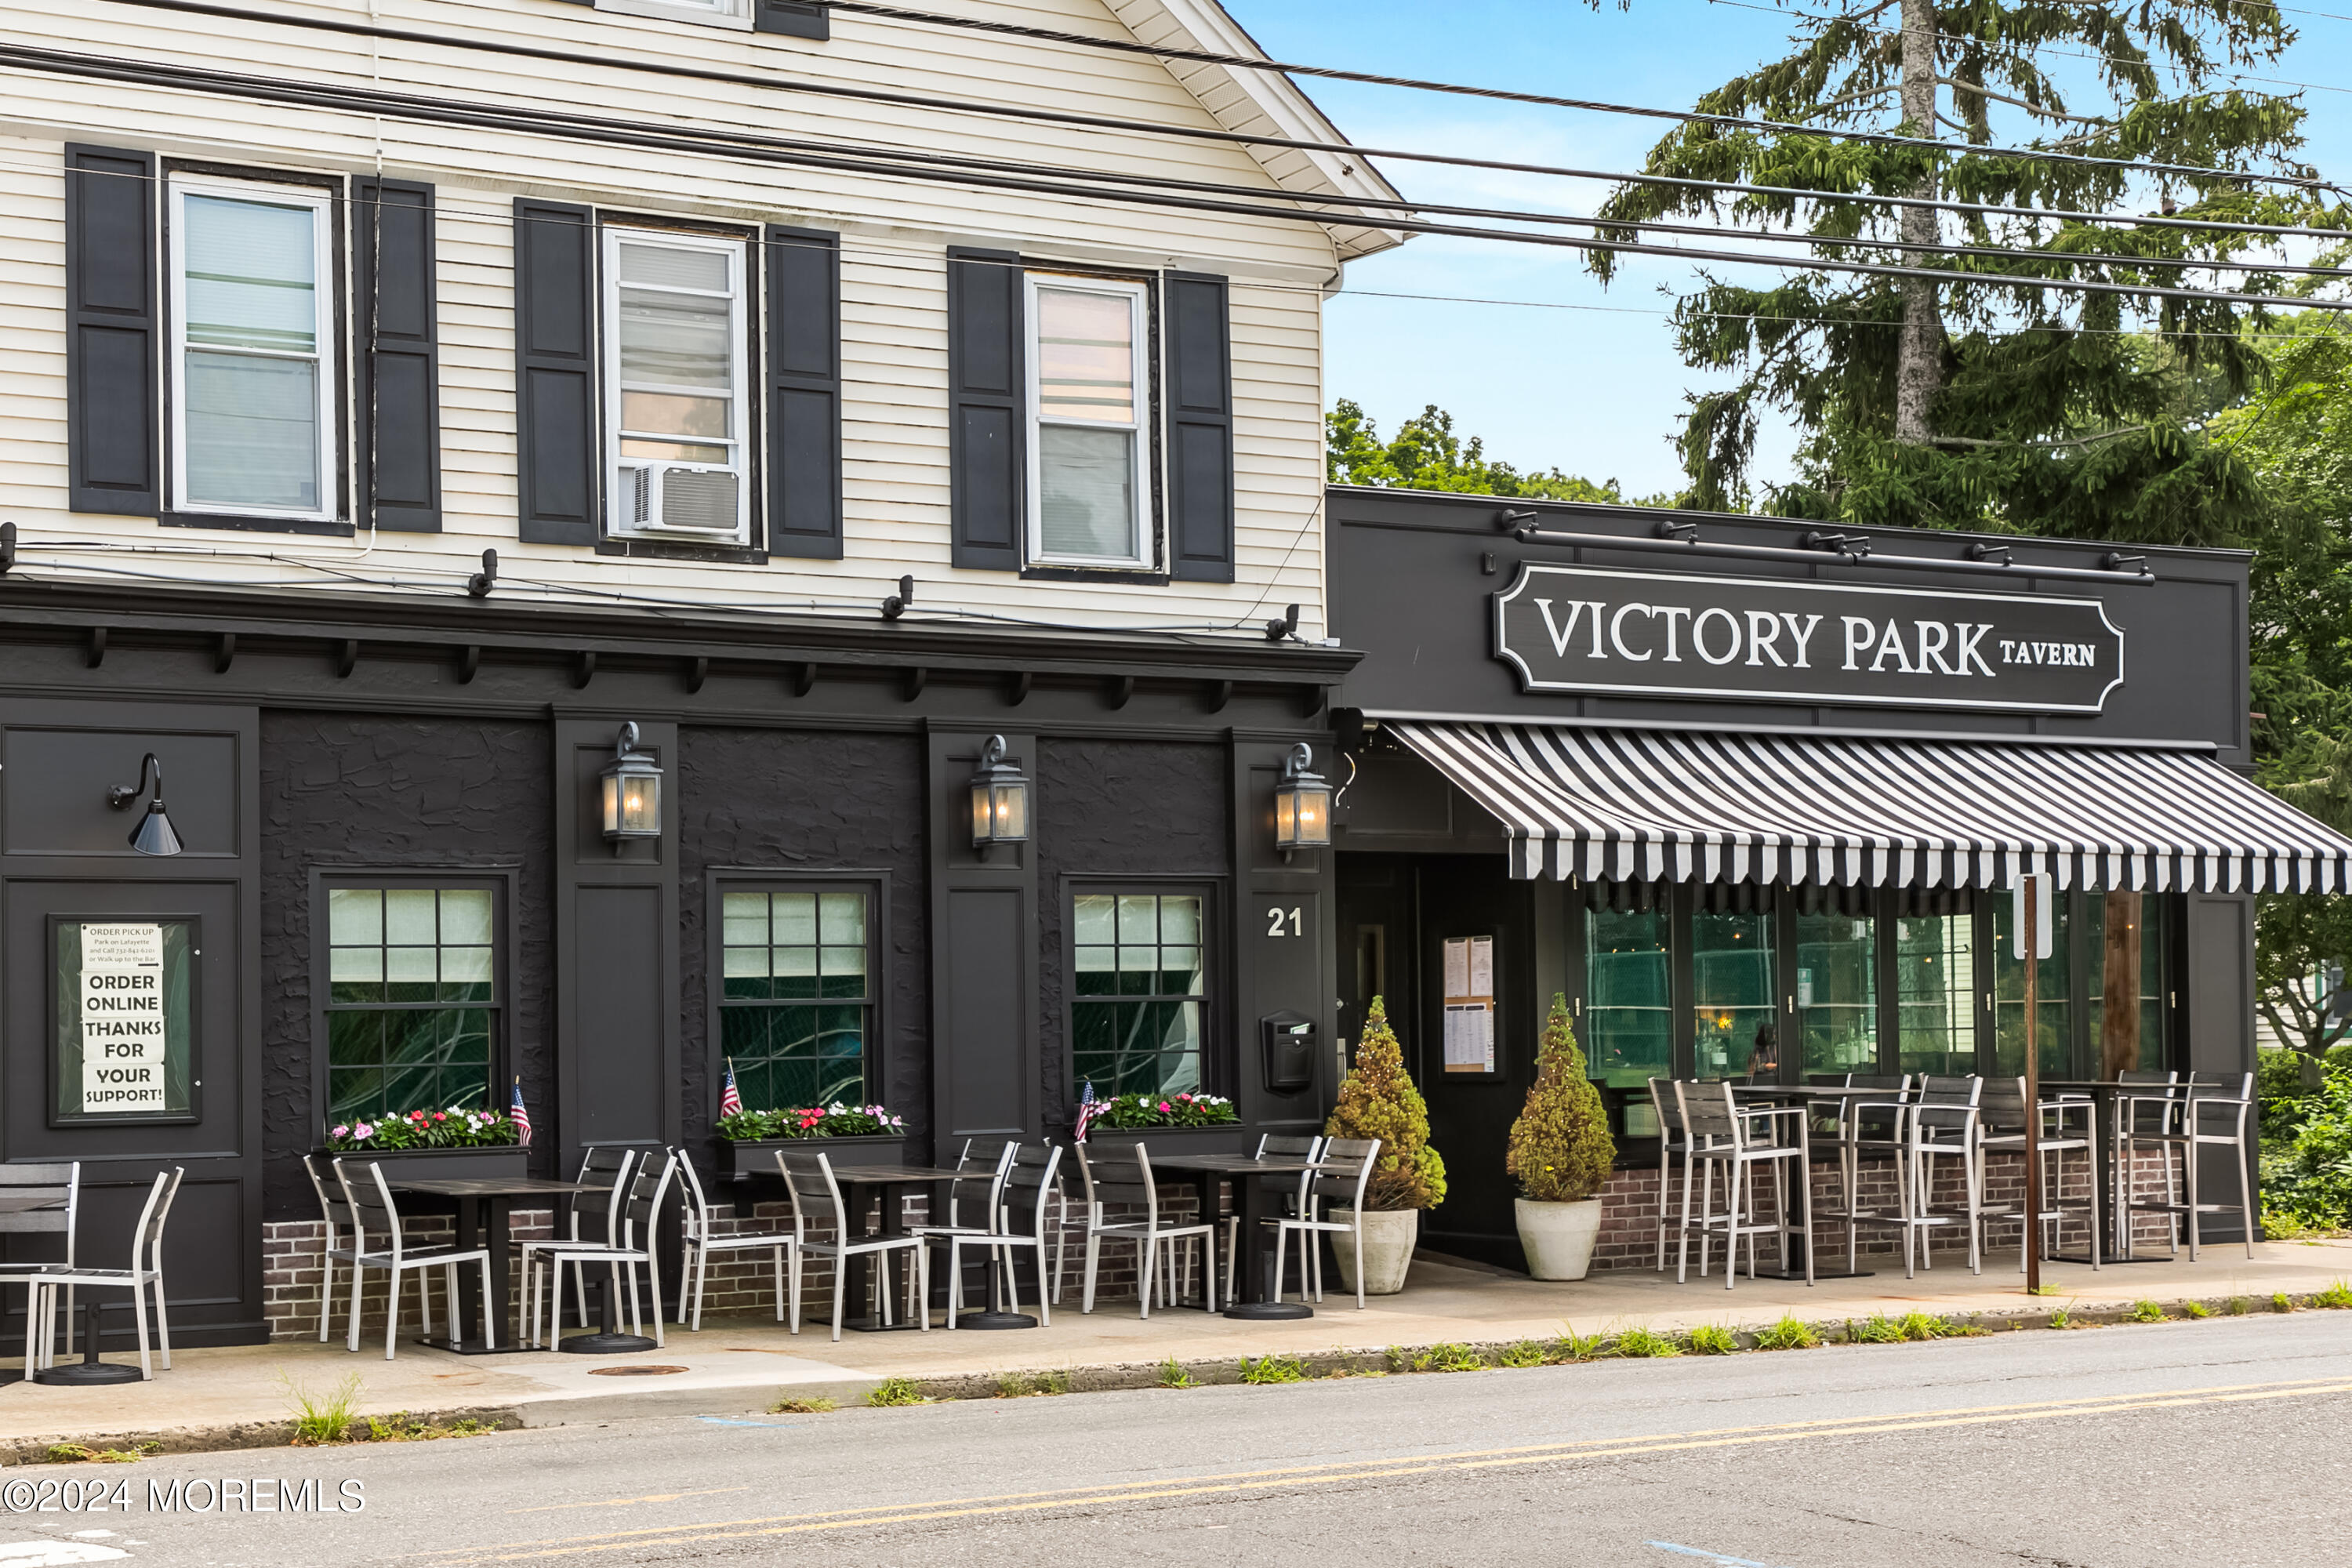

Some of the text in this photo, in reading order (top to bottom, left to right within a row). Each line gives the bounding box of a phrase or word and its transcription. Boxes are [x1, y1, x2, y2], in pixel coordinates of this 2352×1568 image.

[1534, 598, 2096, 677] VICTORY PARK TAVERN
[1268, 907, 1301, 936] 21
[89, 975, 154, 989] ORDER
[86, 996, 158, 1011] ONLINE
[85, 1021, 162, 1036] THANKS
[104, 1044, 144, 1058] FOR
[96, 1069, 151, 1083] YOUR
[86, 1089, 162, 1102] SUPPORT!
